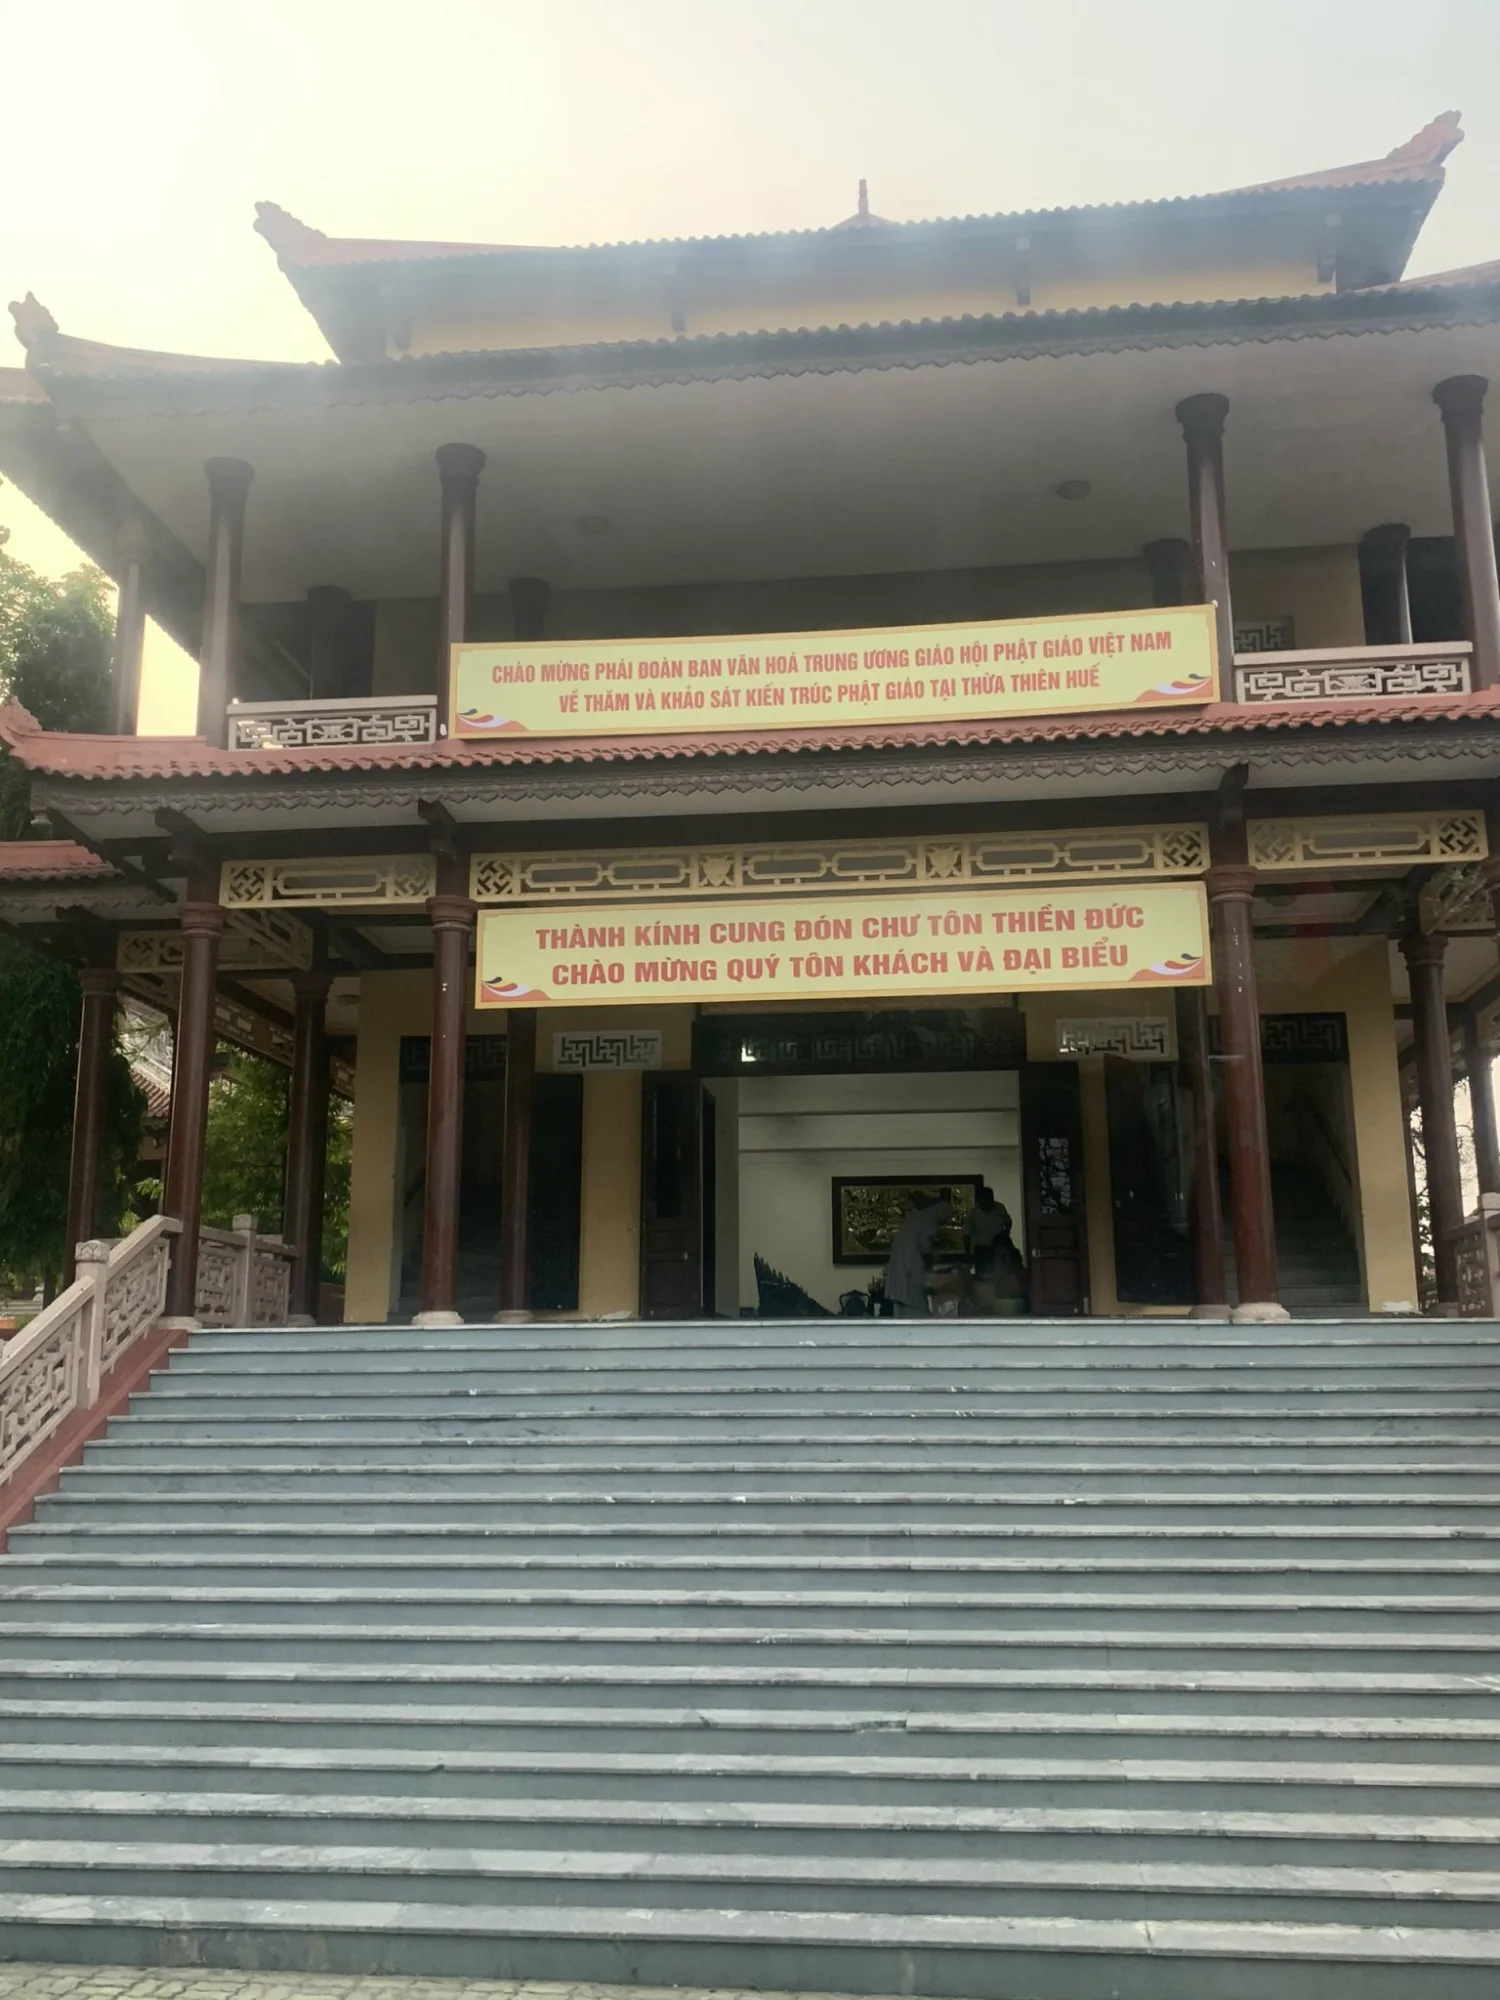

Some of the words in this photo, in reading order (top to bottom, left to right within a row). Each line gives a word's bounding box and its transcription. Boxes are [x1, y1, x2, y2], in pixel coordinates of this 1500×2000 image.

[492, 661, 535, 684] CHÀO
[595, 658, 633, 681] PHÁI
[637, 657, 683, 680] ĐOÀN
[688, 658, 722, 678] BAN
[727, 654, 760, 676] VĂN
[765, 652, 798, 675] HOÁ
[804, 652, 858, 673] TRUNG
[864, 648, 909, 670] ƯƠNG
[915, 644, 954, 666] GIÁO
[960, 641, 988, 667] HỘI
[993, 638, 1037, 664] PHẬT
[1042, 635, 1083, 658] GIÁO
[1088, 632, 1125, 658] VIỆT
[1131, 631, 1172, 652] NAM
[584, 690, 630, 712] THĂM
[635, 689, 656, 711] VÀ
[661, 685, 705, 710] KHẢO
[710, 686, 741, 708] SÁT
[790, 683, 832, 705] TRÚC
[837, 680, 880, 706] PHẬT
[885, 677, 924, 700] GIÁO
[930, 678, 956, 701] TẠI
[961, 672, 1005, 695] THỪA
[1011, 669, 1060, 692] THIÊN
[1066, 662, 1100, 688] HUẾ
[536, 924, 625, 949] THÀNH
[634, 921, 700, 946] KÍNH
[710, 921, 785, 944] CUNG
[794, 915, 852, 941] ĐÓN
[862, 914, 921, 939] CHƯ
[927, 910, 983, 936] TÔN
[1085, 903, 1144, 930] ĐỨC
[552, 959, 625, 985] CHÀO
[634, 957, 717, 982] MỪNG
[727, 953, 780, 982] QUÝ
[789, 952, 844, 977] TÔN
[854, 949, 948, 976] KHÁCH
[957, 946, 994, 972] VÀ
[1003, 948, 1051, 974] ĐẠI
[1062, 937, 1128, 968] BIỂU
